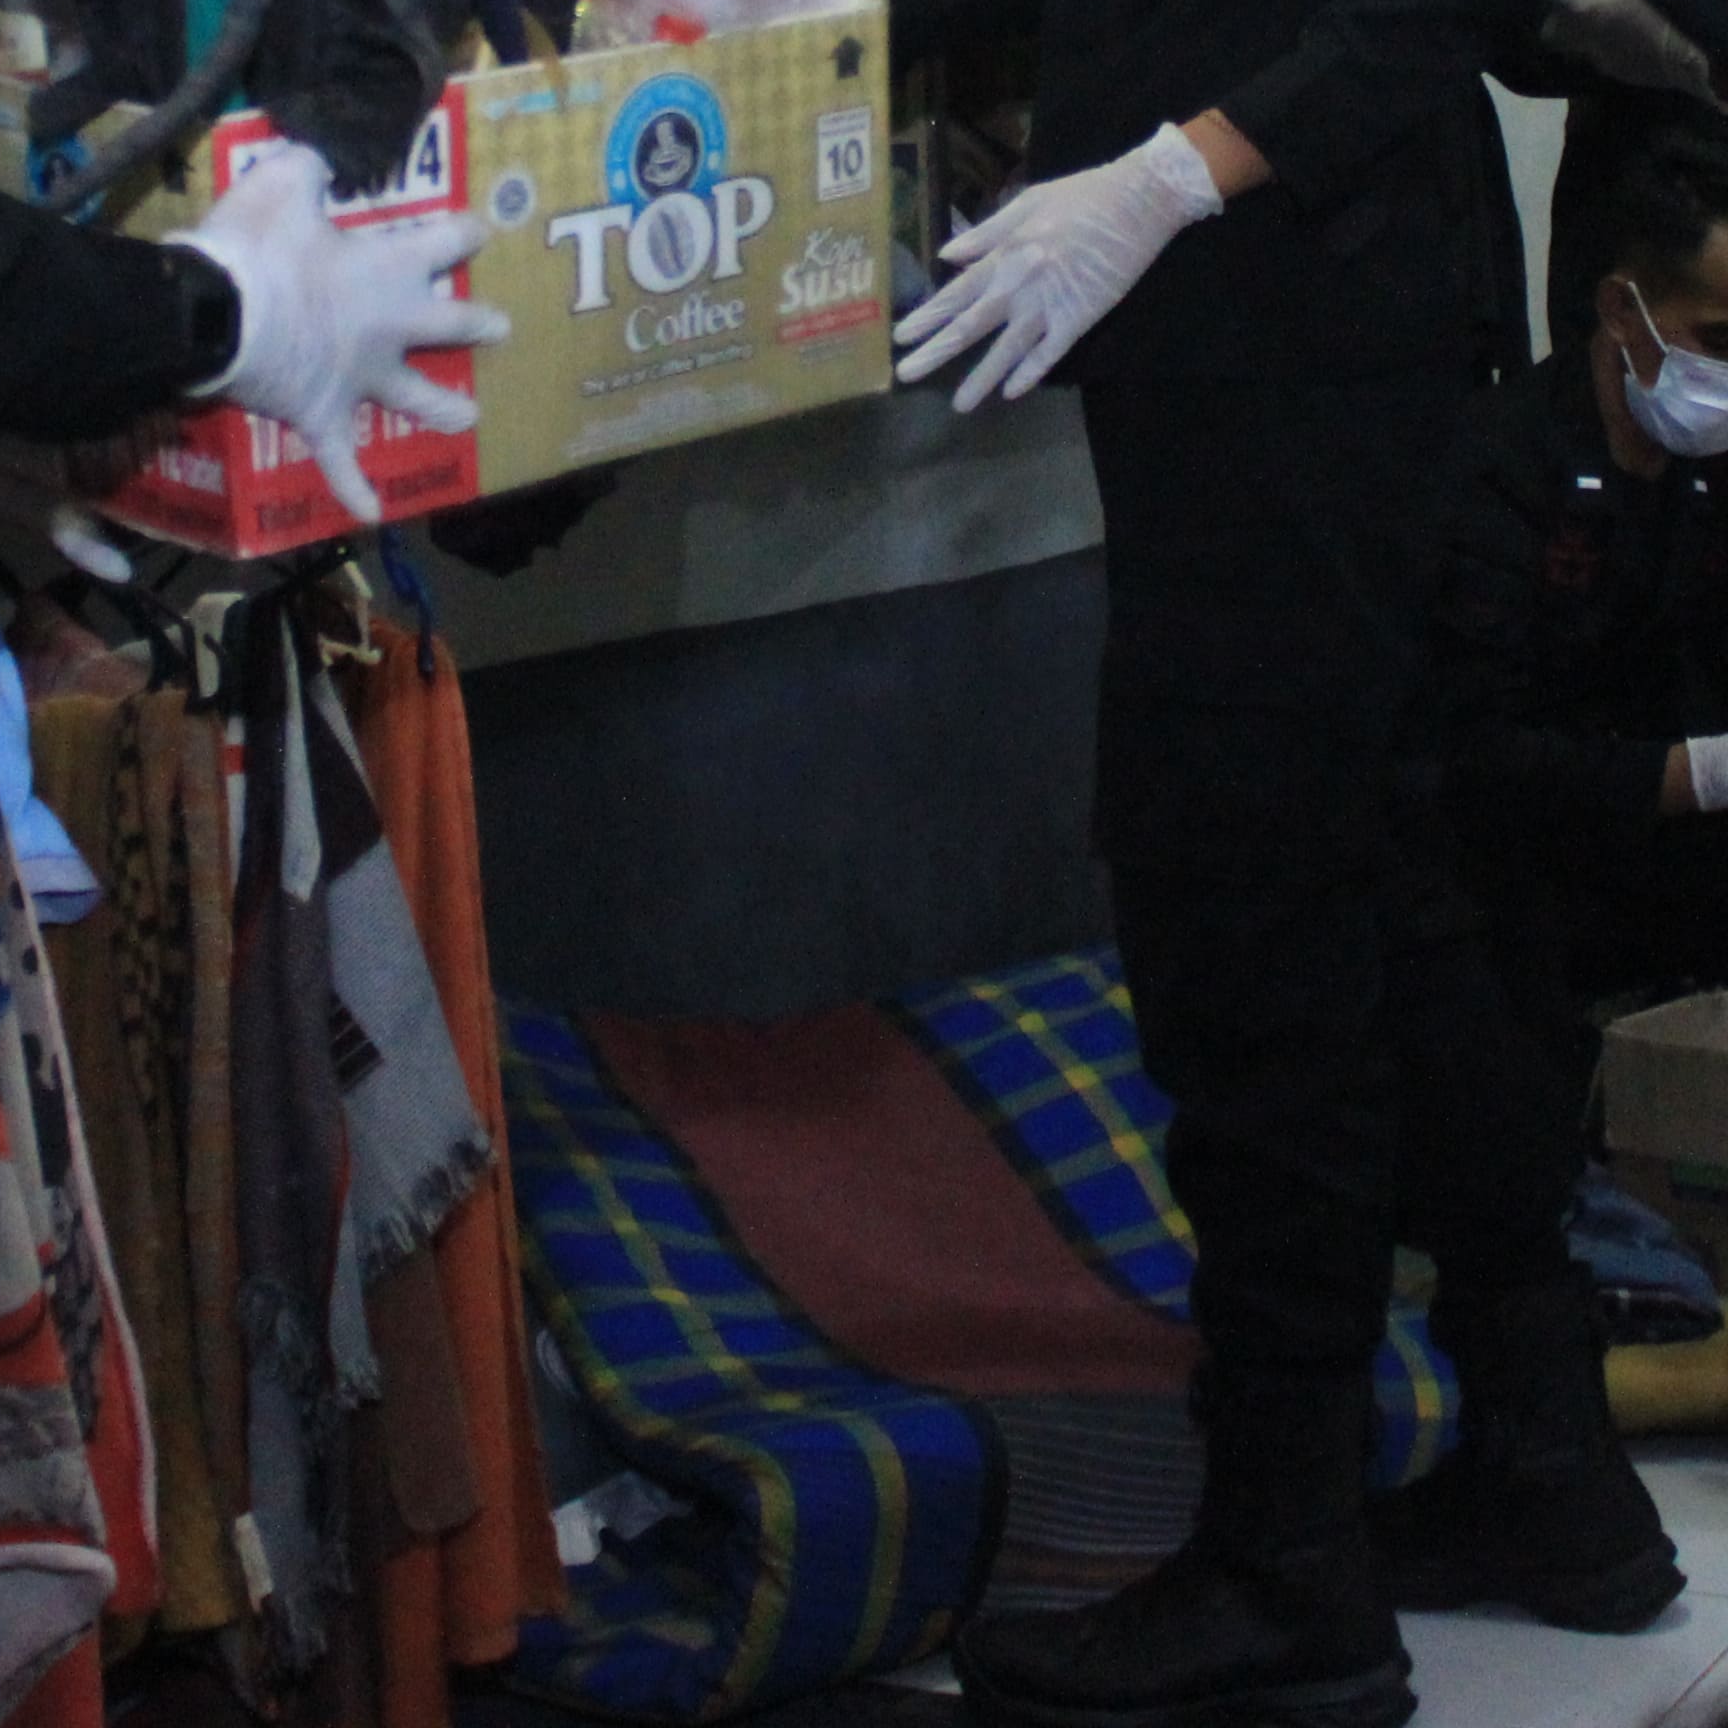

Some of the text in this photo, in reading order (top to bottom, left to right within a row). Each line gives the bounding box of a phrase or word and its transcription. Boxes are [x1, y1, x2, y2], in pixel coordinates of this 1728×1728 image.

[825, 137, 866, 182] 10
[547, 175, 775, 314] TOP
[624, 289, 748, 353] Coffee
